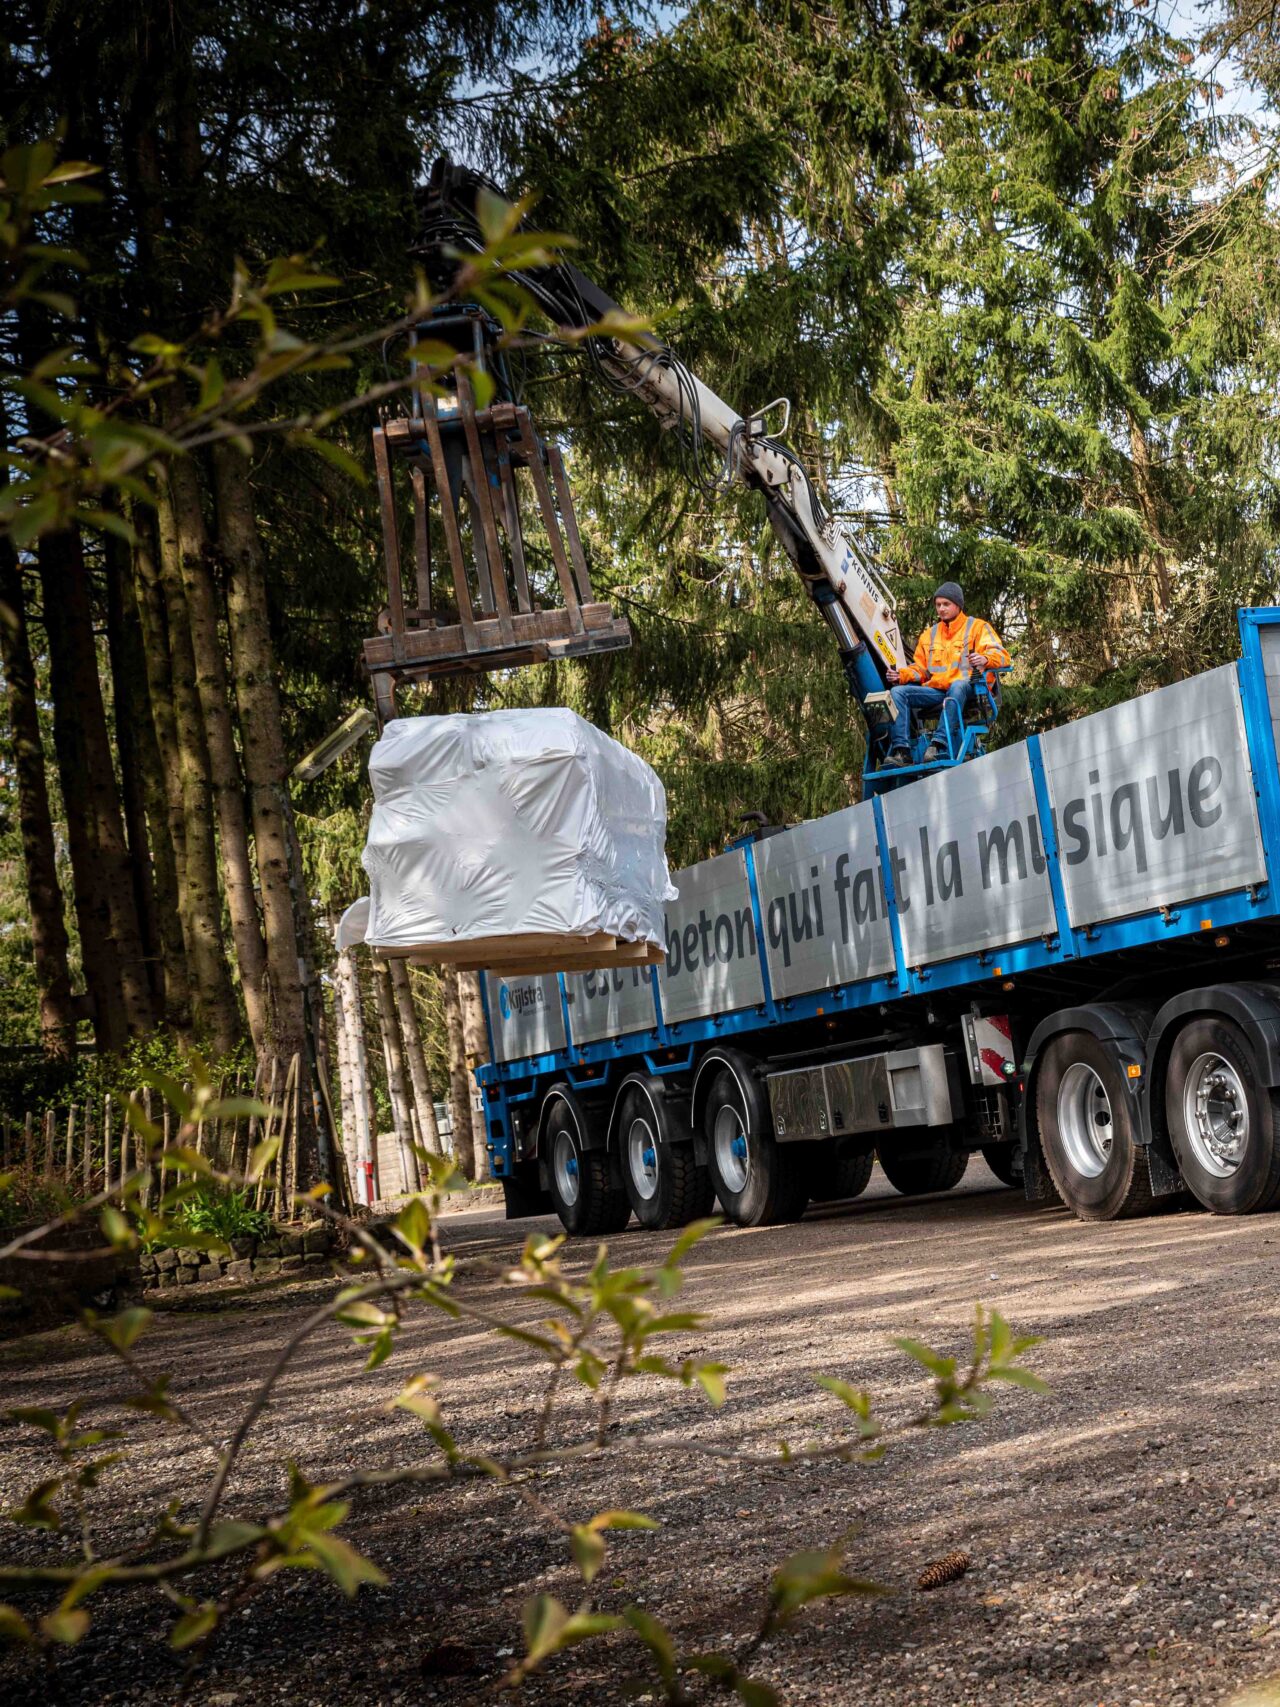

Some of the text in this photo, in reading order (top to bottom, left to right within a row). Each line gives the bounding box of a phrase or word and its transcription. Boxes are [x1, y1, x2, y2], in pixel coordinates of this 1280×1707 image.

[851, 559, 879, 603] KENNIS
[664, 907, 757, 978] beton
[767, 865, 825, 968] qui
[833, 844, 911, 945] fait
[919, 826, 964, 906] la
[978, 755, 1223, 890] musique
[508, 984, 544, 1014] Kijlstra
